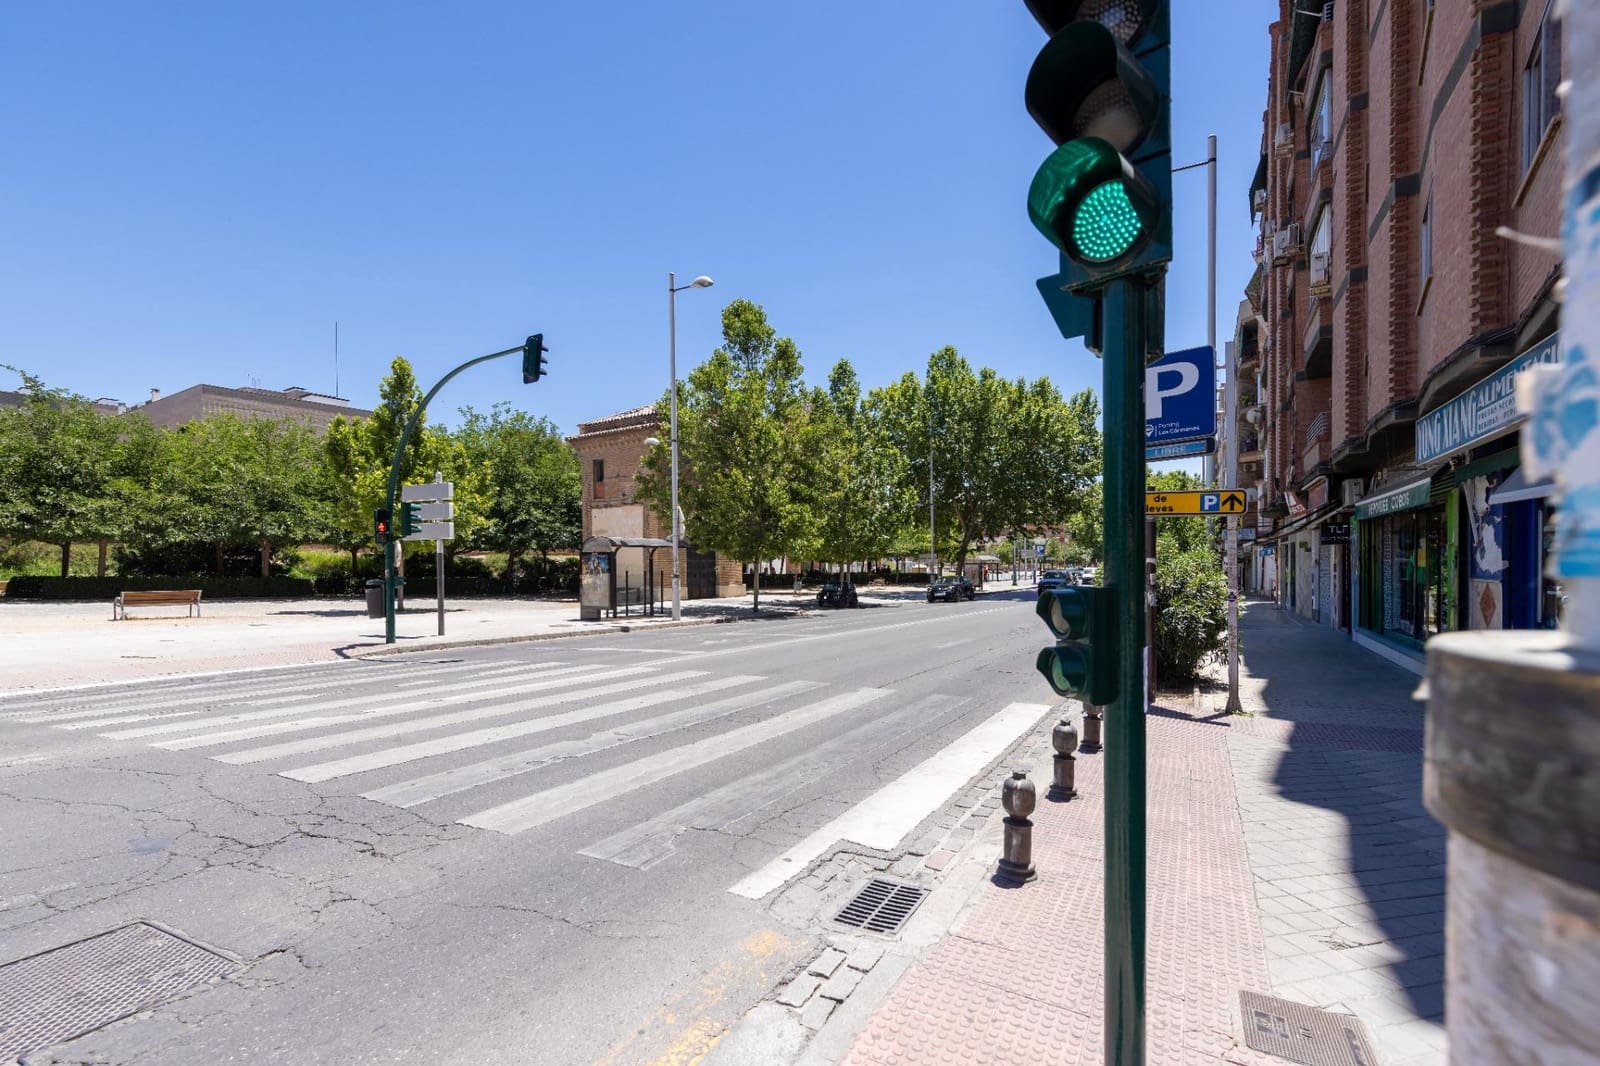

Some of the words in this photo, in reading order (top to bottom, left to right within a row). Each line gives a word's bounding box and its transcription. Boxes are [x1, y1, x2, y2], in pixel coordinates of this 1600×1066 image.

[1145, 362, 1199, 420] P
[1442, 390, 1477, 450] XIANG
[1153, 494, 1167, 502] de
[1204, 495, 1217, 510] P
[1145, 504, 1174, 512] ieves
